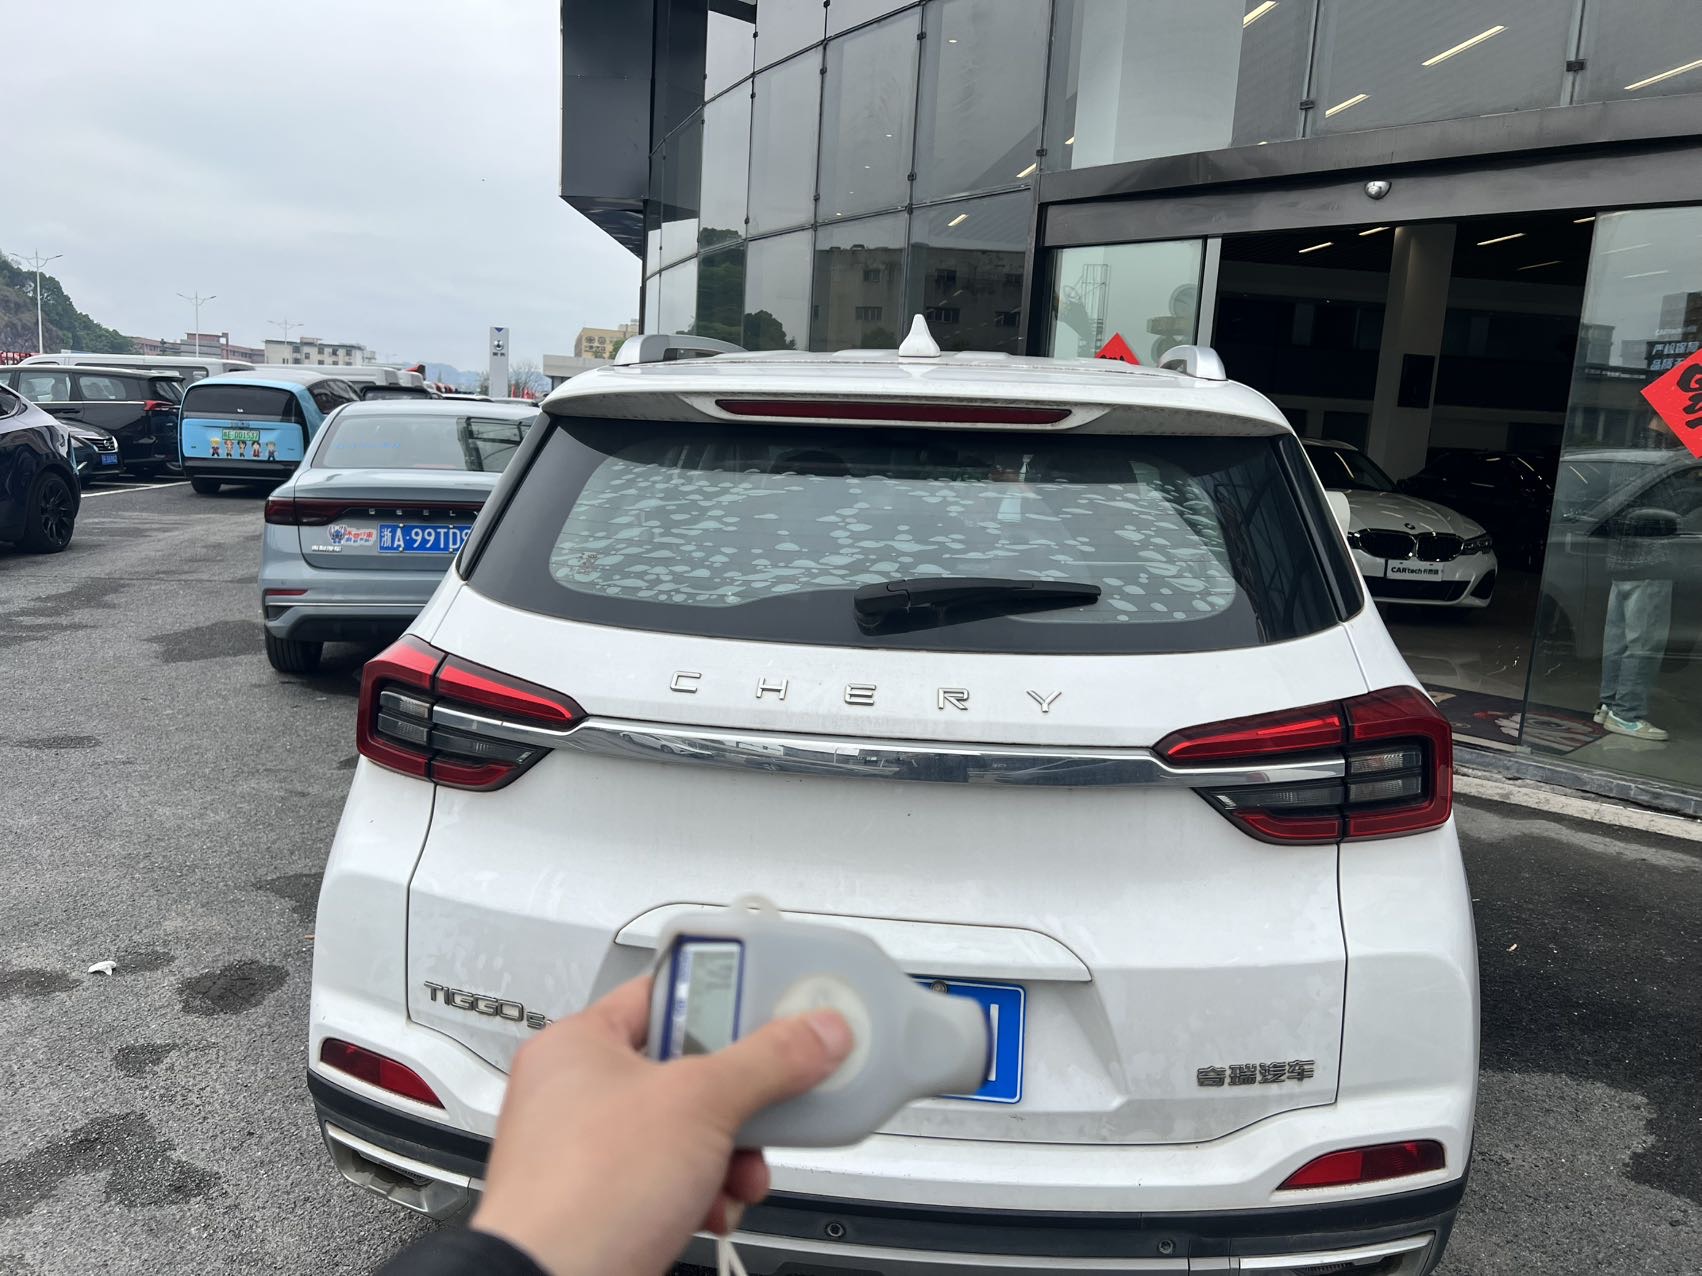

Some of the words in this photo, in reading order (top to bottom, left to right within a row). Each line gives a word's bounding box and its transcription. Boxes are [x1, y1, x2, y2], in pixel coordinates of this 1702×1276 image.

[669, 670, 1062, 713] CHERY
[424, 980, 524, 1022] TIGGO
[1196, 1059, 1316, 1087] 奇瑞汽车
